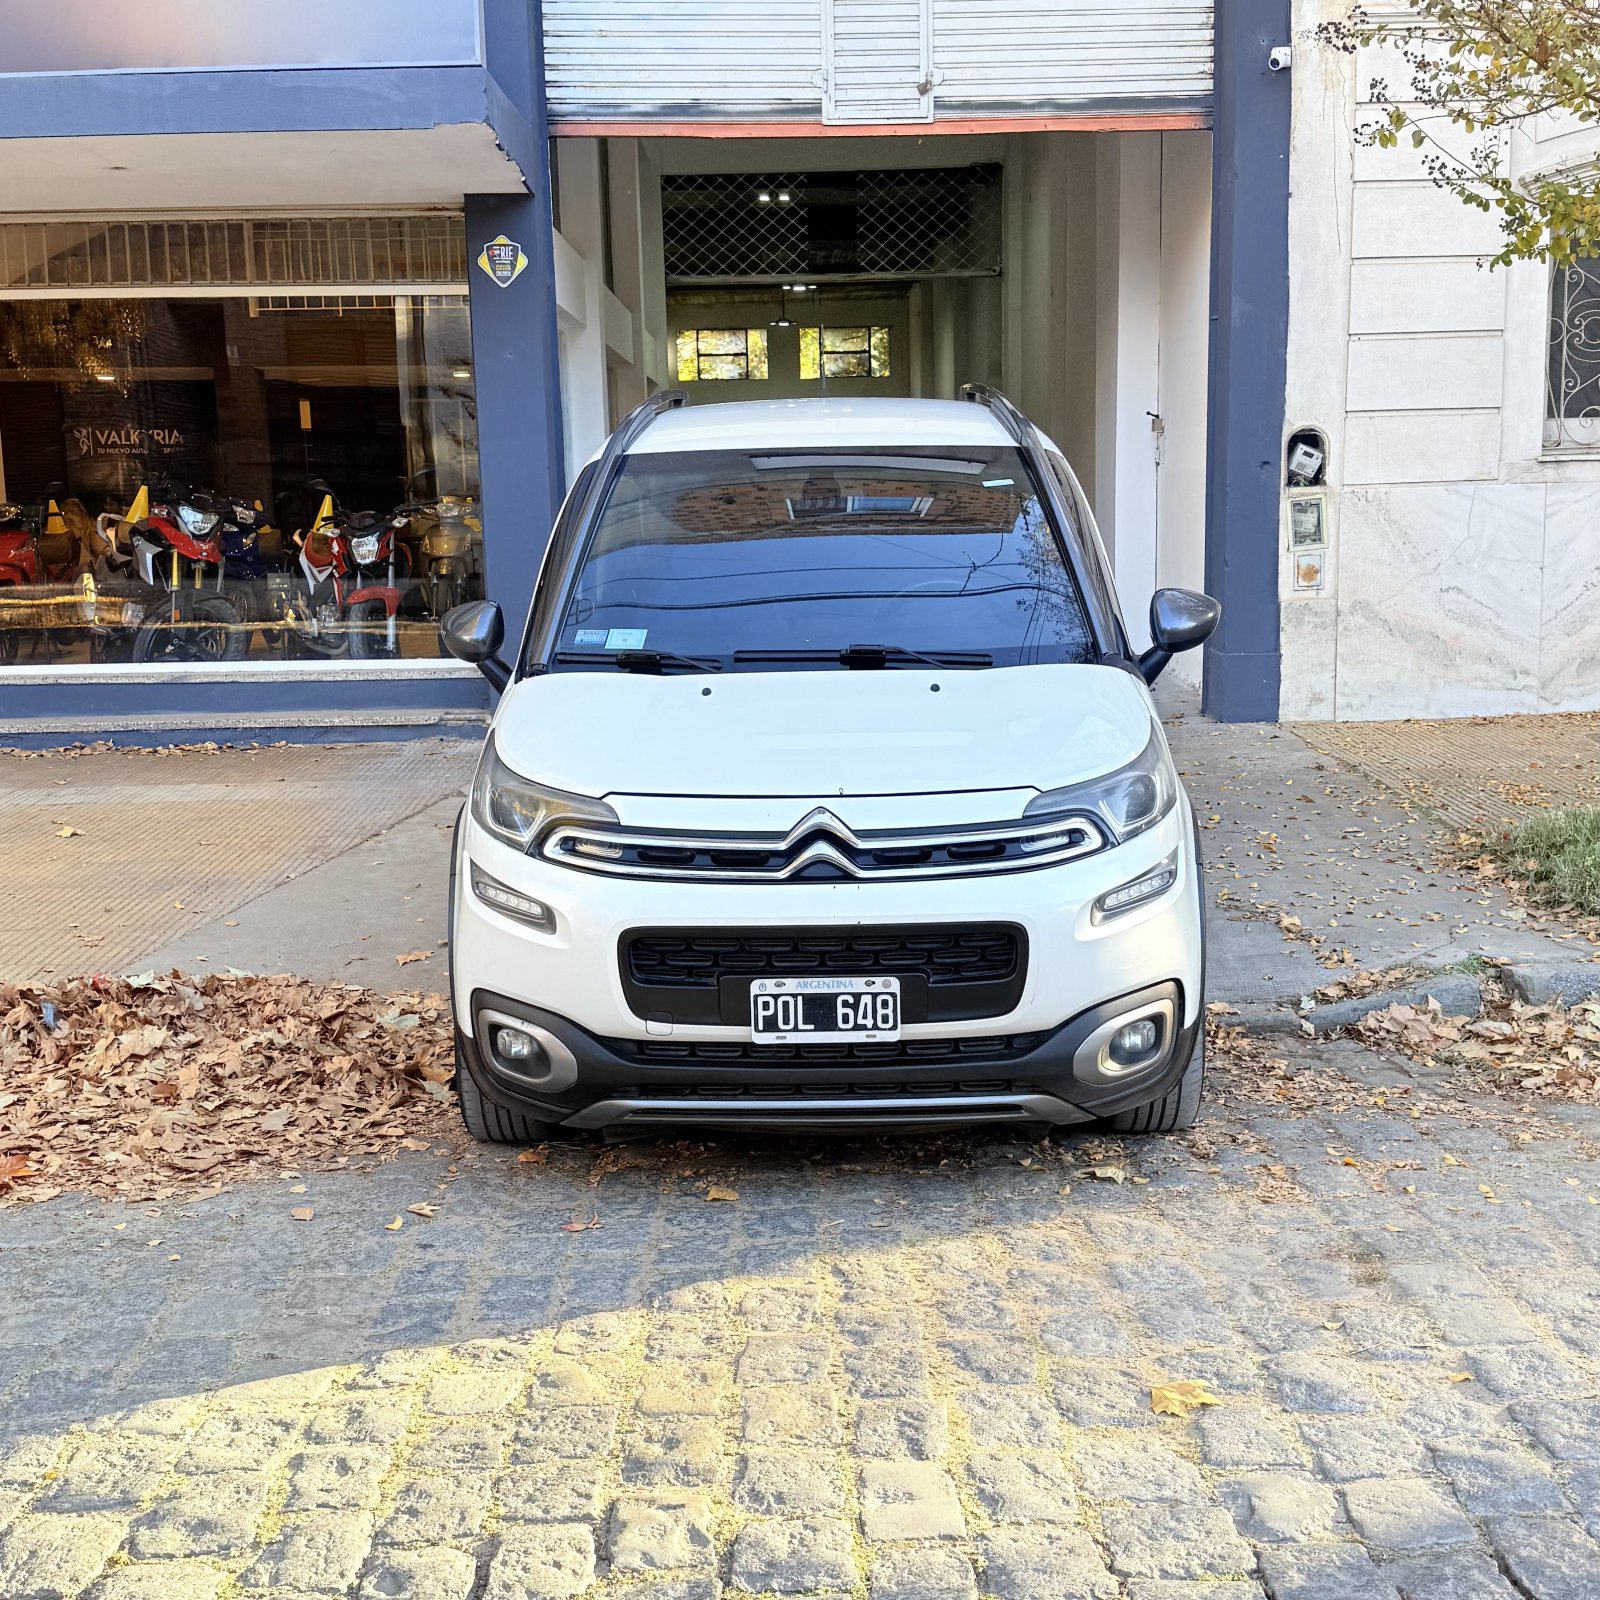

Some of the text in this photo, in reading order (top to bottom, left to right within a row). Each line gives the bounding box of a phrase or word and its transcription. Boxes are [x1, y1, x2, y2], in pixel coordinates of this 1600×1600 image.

[795, 980, 854, 989] ARGENTINA
[757, 994, 894, 1031] POL 648
